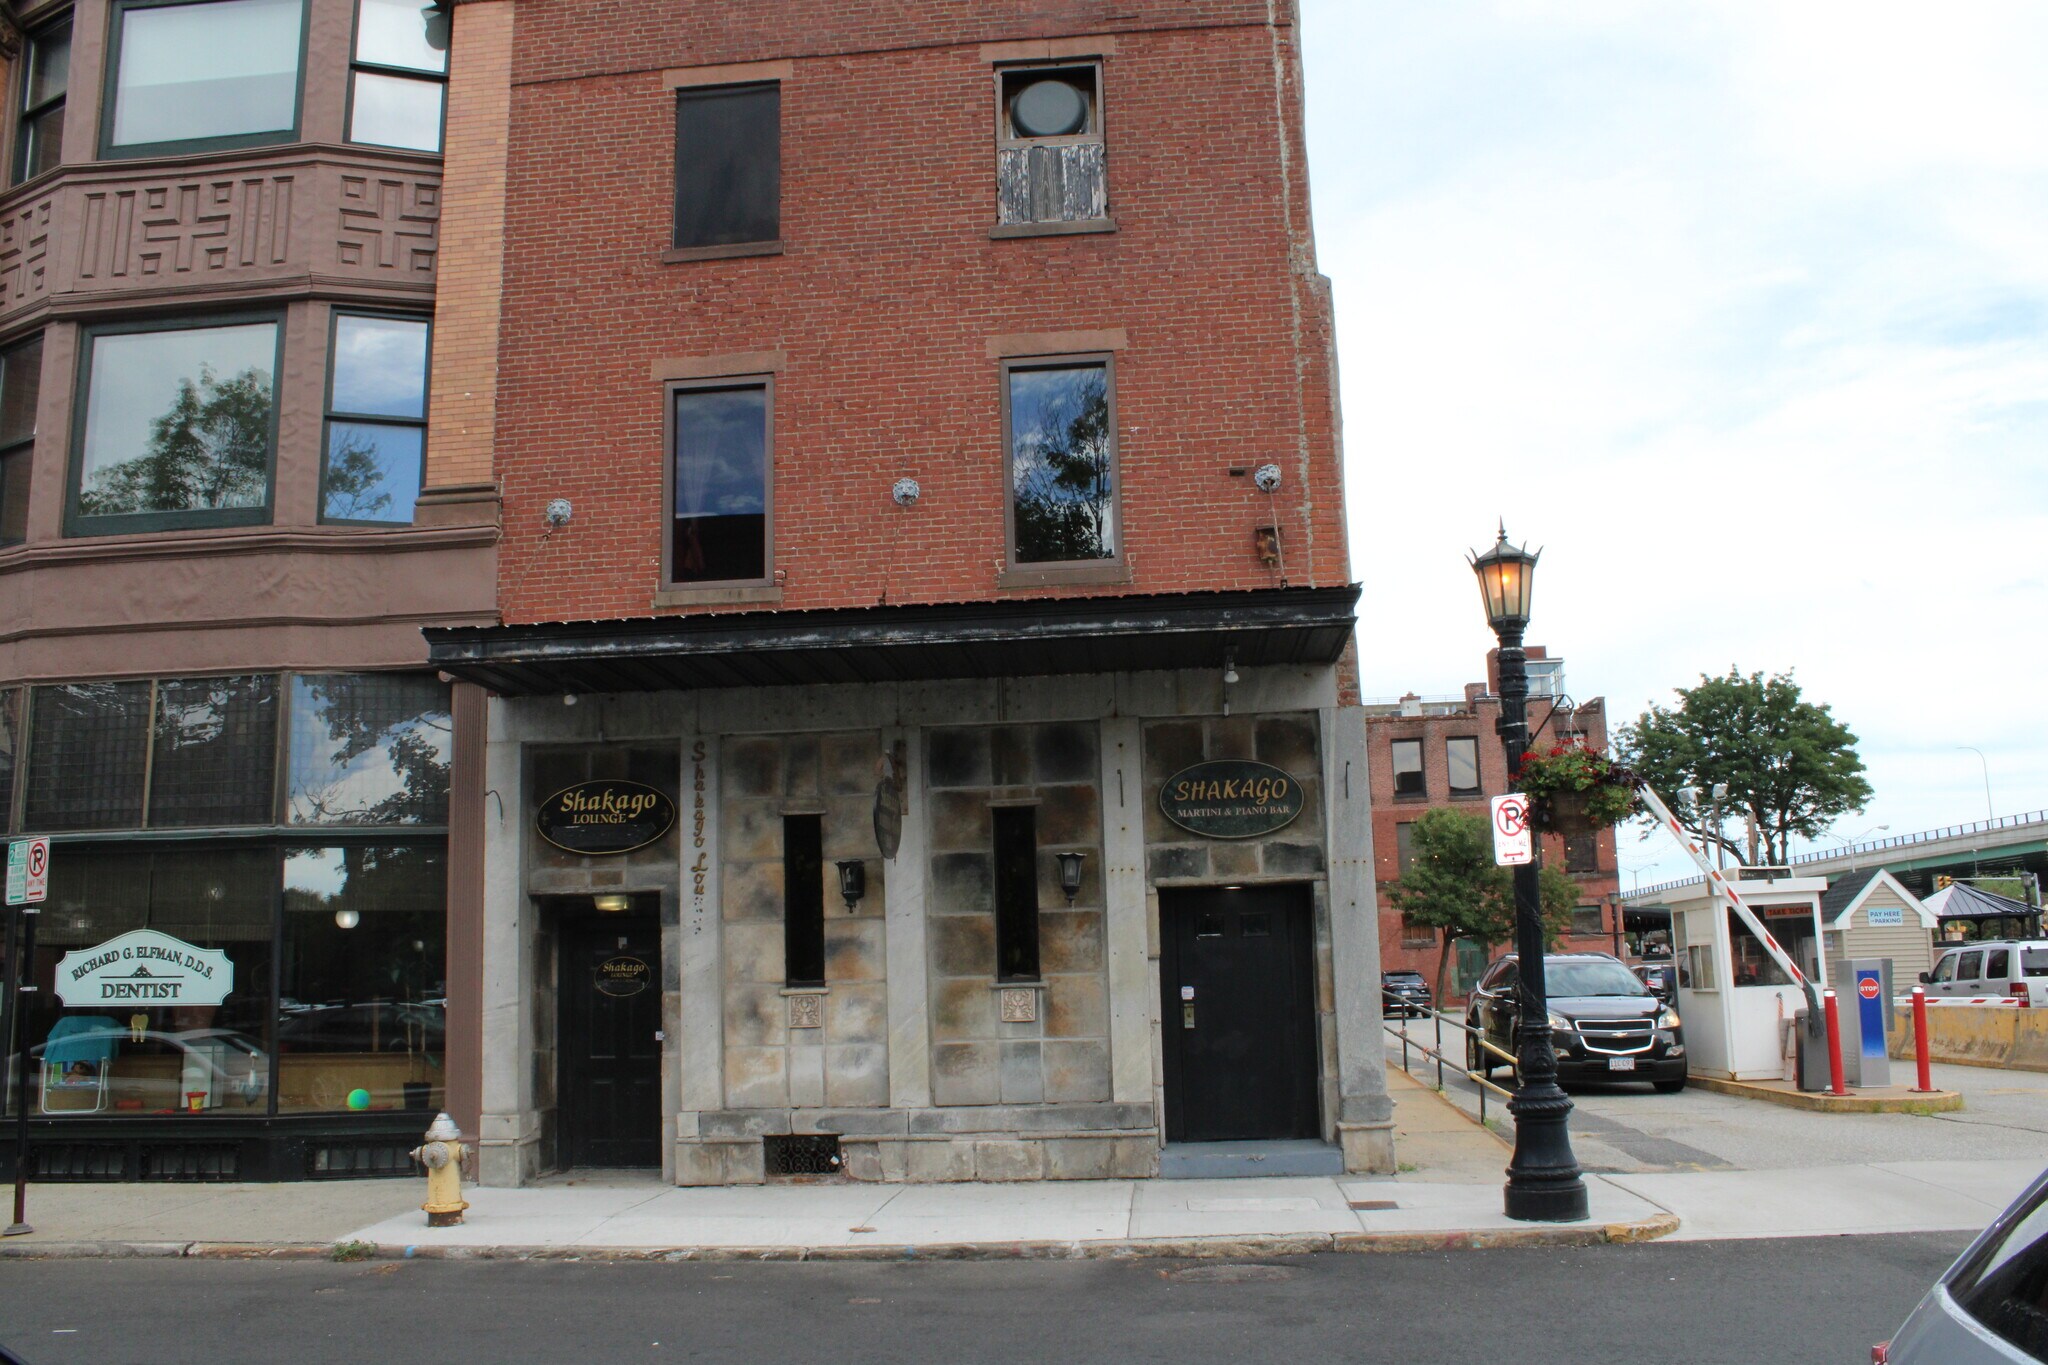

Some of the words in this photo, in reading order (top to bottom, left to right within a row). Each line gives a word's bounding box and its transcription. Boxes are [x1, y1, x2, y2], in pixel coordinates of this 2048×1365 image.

[1174, 777, 1288, 805] SHAKAGO
[560, 788, 657, 818] Shakago
[573, 813, 627, 824] LOUNGE
[1177, 808, 1221, 818] MARTINI
[1224, 808, 1232, 816] &
[1235, 806, 1267, 816] PIANO
[1269, 805, 1290, 814] BAR
[27, 879, 35, 887] ANY
[36, 877, 45, 887] TIME
[71, 950, 120, 981] RICHARD
[123, 947, 133, 960] G.
[136, 946, 183, 967] ELFMAN,
[184, 955, 214, 980] D.D.S.
[602, 961, 645, 975] Shakago
[101, 983, 182, 999] DENTIST
